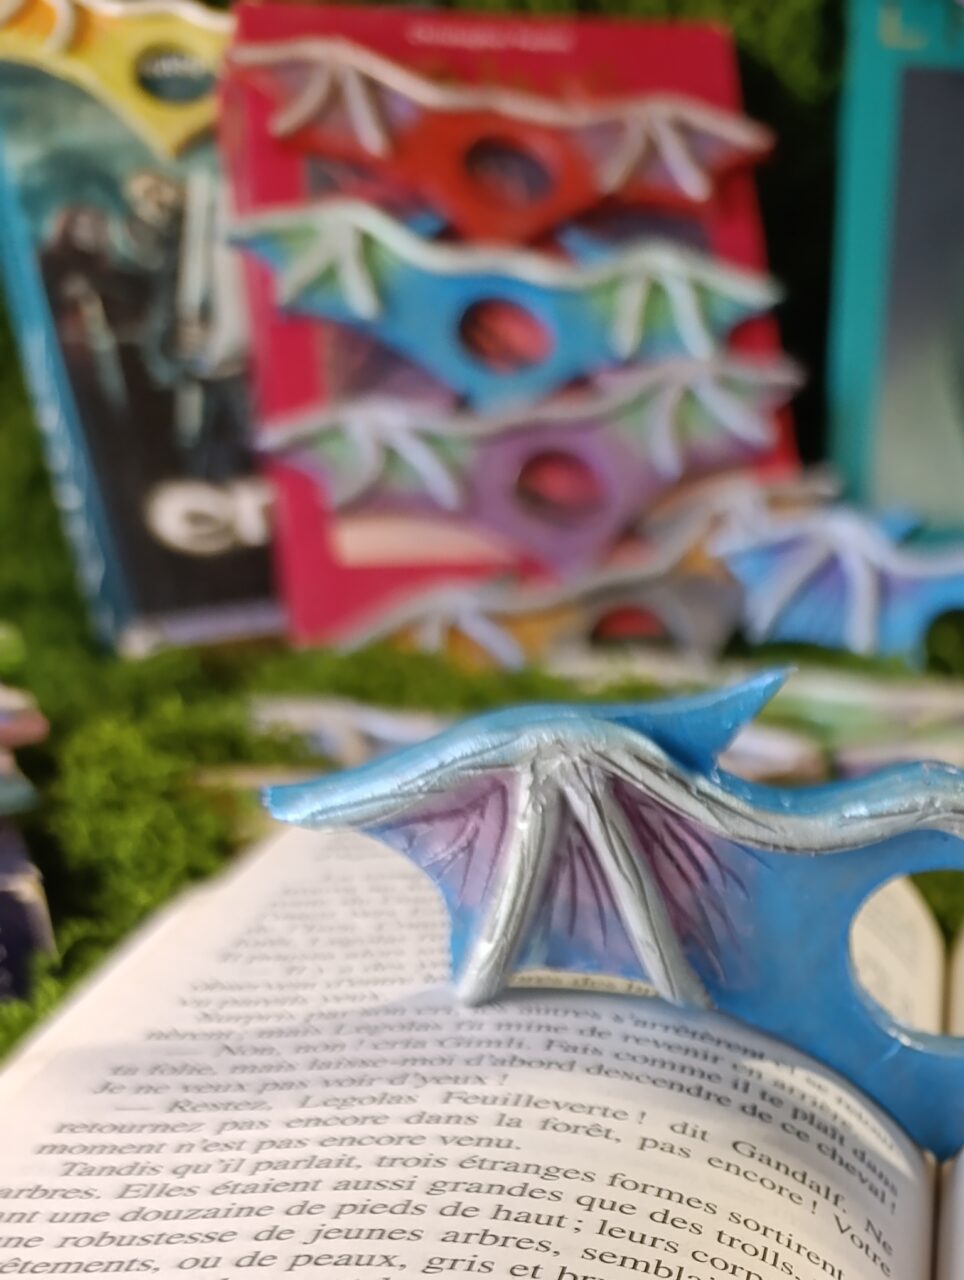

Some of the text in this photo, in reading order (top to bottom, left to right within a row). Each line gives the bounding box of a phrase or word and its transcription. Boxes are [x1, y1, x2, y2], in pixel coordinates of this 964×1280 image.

[60, 1161, 162, 1177] Tandis
[170, 1158, 245, 1178] qu'il
[248, 1154, 362, 1176] parlait,
[376, 1153, 448, 1169] trois
[459, 1155, 596, 1182] étranges
[608, 1172, 717, 1215] formes
[114, 1183, 201, 1200] Elles
[210, 1178, 321, 1196] étaient
[332, 1175, 418, 1192] aussi
[425, 1180, 564, 1202] grandes
[576, 1194, 637, 1216] que
[648, 1208, 703, 1236] des
[48, 1211, 111, 1223] une
[119, 1203, 276, 1222] douzaine
[284, 1199, 326, 1216] de
[331, 1198, 428, 1219] pieds
[439, 1201, 480, 1218] de
[595, 1219, 680, 1255] leurs
[54, 1231, 238, 1248] robustesse
[253, 1225, 296, 1242] de
[302, 1224, 425, 1245] jeunes
[439, 1228, 561, 1257] arbres,
[176, 1257, 222, 1270] ou
[234, 1251, 279, 1268] de
[285, 1253, 407, 1272] peaux,
[421, 1254, 495, 1275] gris
[509, 1261, 544, 1280] et
